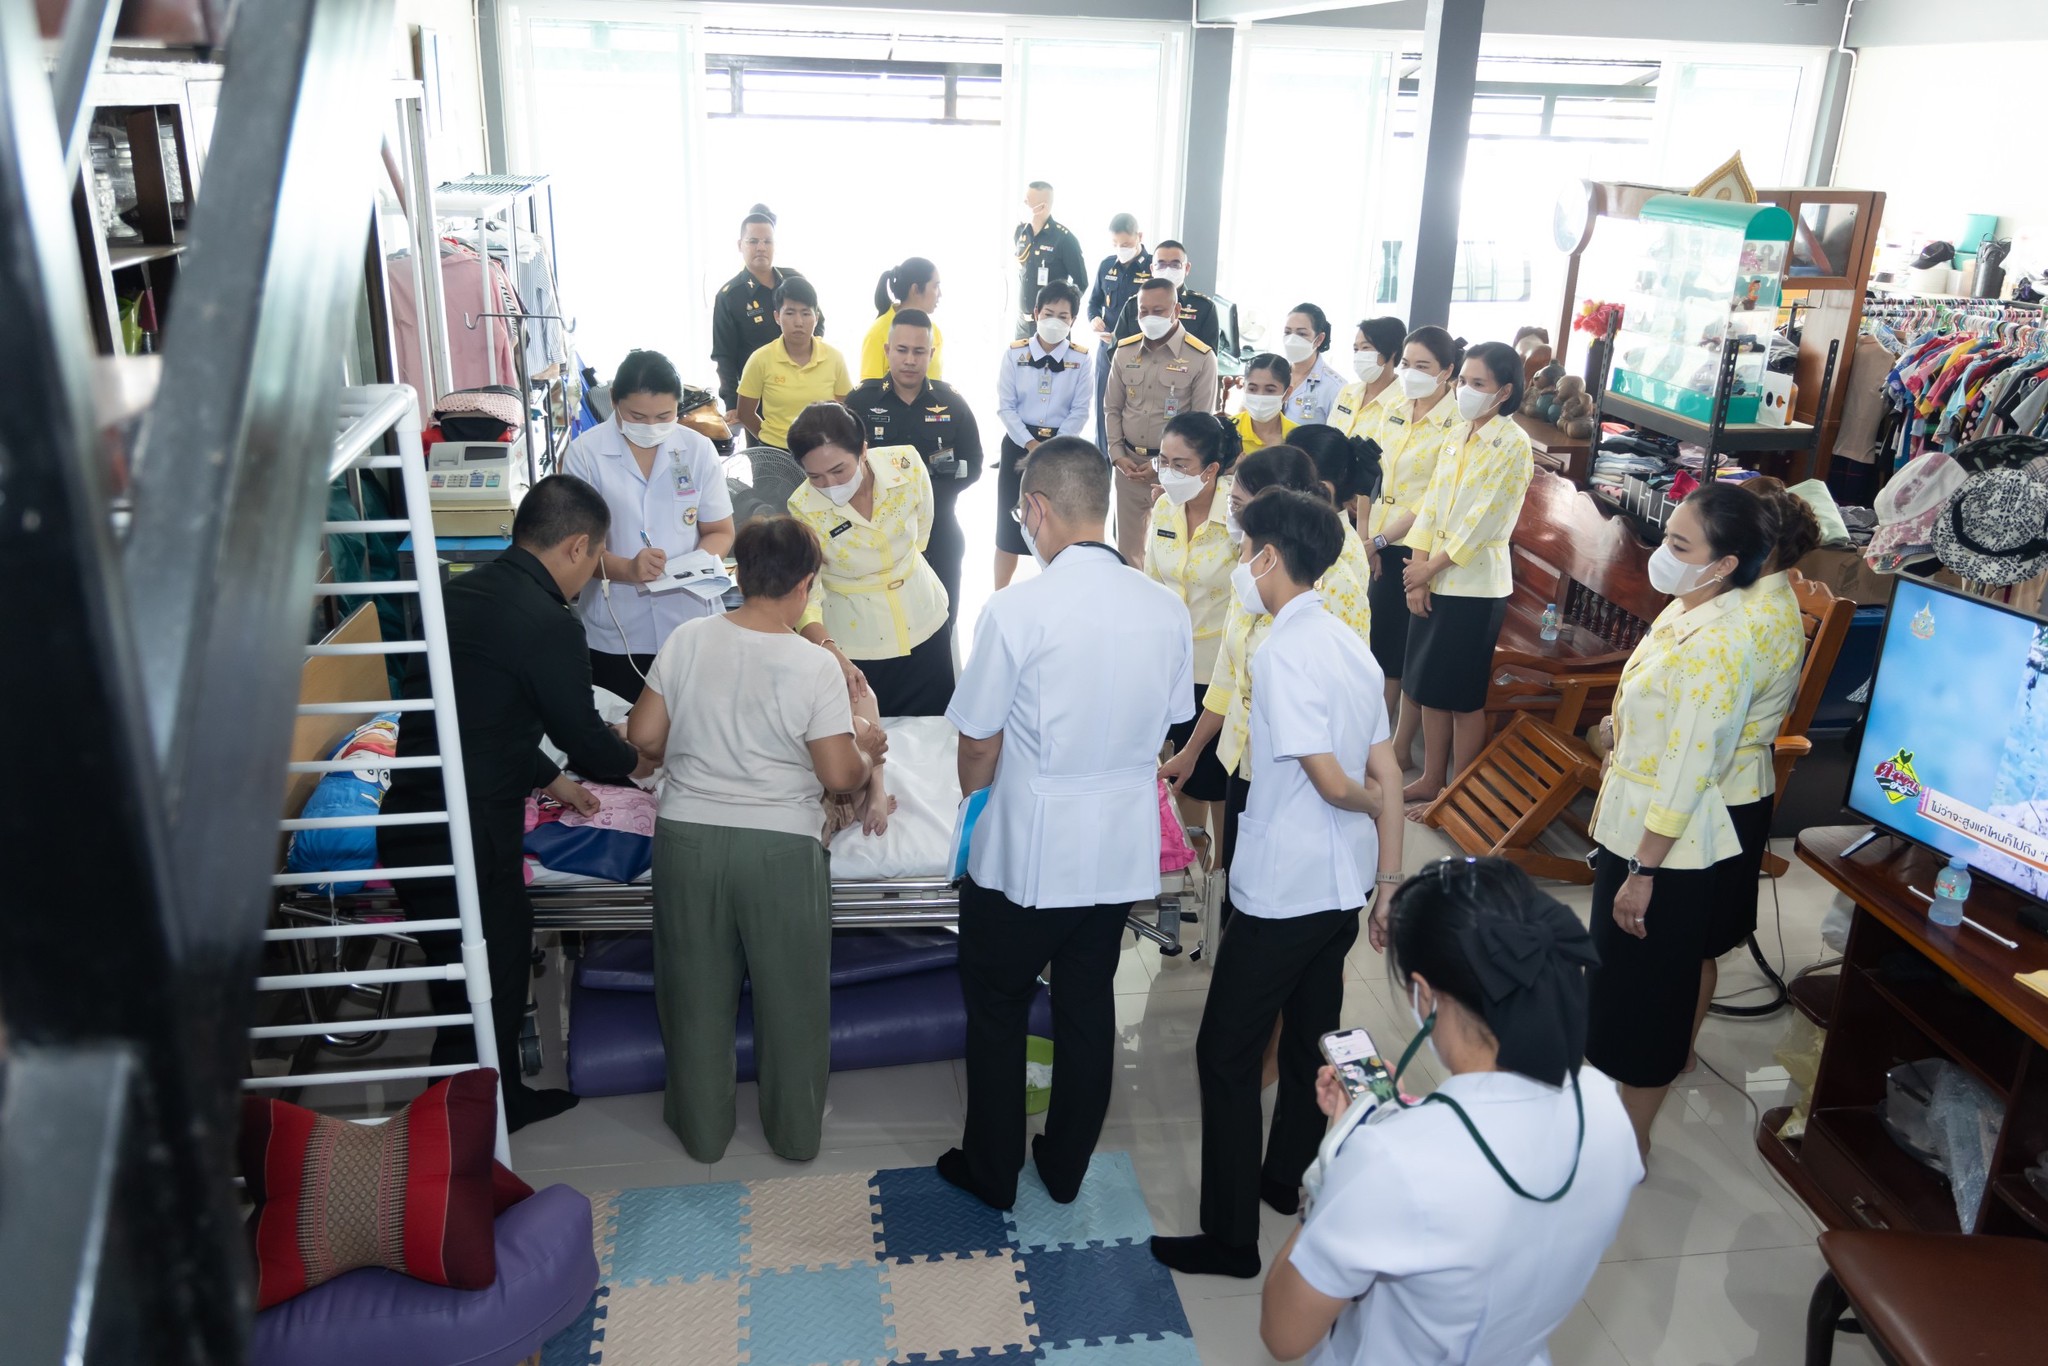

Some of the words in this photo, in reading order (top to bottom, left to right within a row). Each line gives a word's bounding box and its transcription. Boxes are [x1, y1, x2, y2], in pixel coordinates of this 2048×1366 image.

[1931, 800, 2037, 857] ไม่ว่าจะสูงแค่ไหนก็ไปถึง
